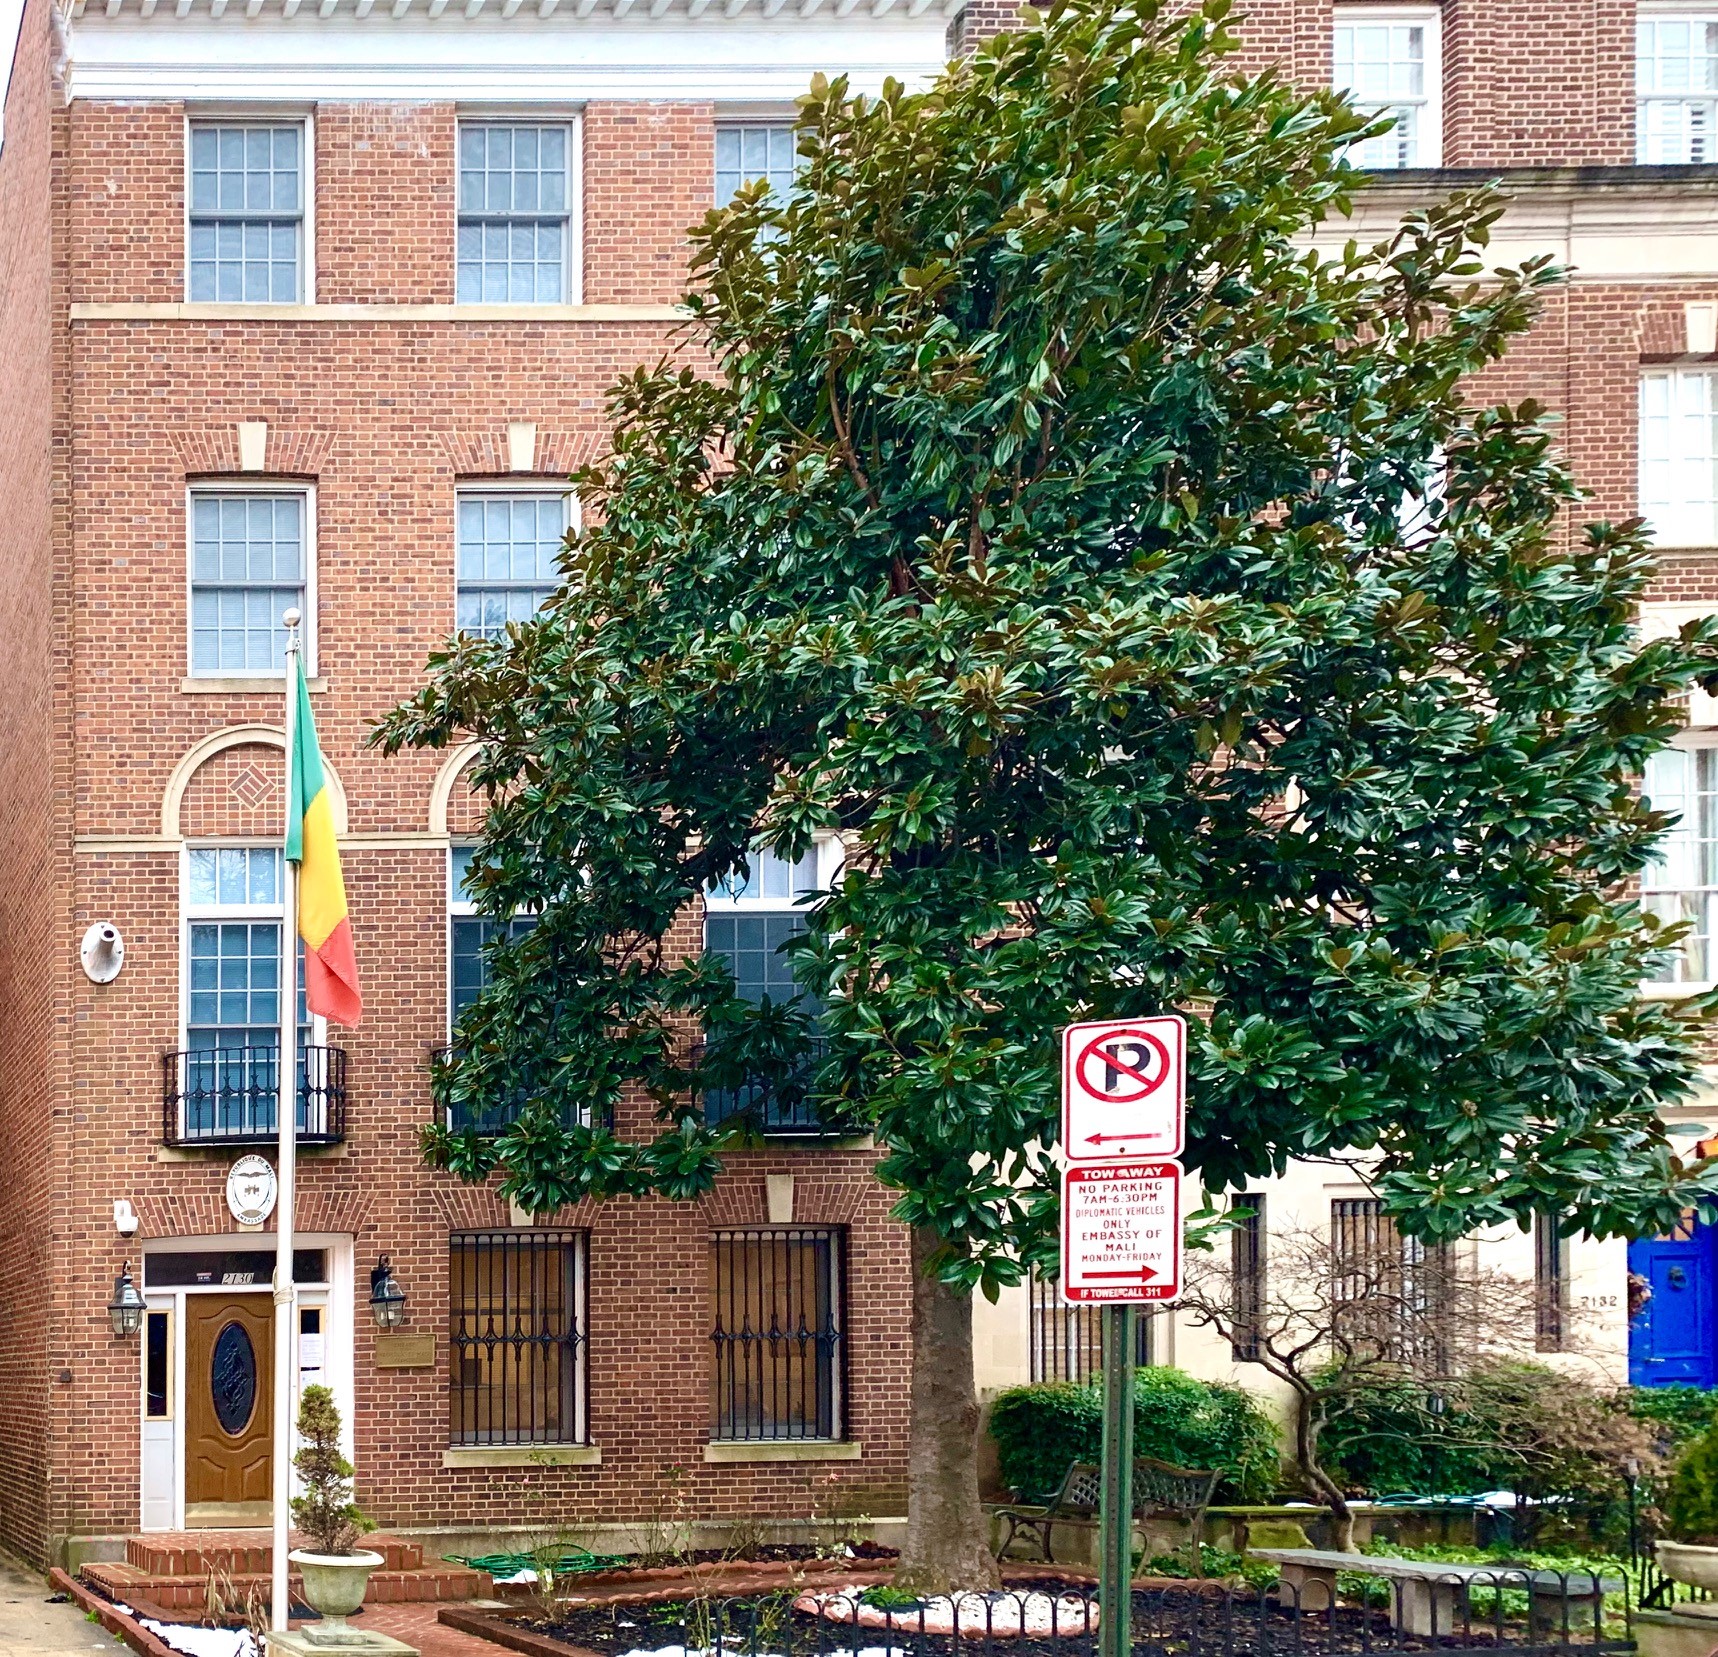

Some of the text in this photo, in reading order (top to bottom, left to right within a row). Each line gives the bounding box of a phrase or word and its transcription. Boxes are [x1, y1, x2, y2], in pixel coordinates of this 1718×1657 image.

[1081, 1166, 1164, 1179] TOW AWAY
[1079, 1181, 1162, 1194] NO PARKING
[1076, 1205, 1165, 1218] DIPLOMATIC VEHICLES
[1103, 1219, 1131, 1229] ONLY
[1082, 1229, 1162, 1241] EMBASSY OF
[1105, 1242, 1136, 1252] MALI
[1081, 1252, 1162, 1263] MONDAY-FRIDAY
[222, 1273, 253, 1284] 2130
[1080, 1289, 1089, 1298] IF
[1123, 1287, 1144, 1297] CALL
[1145, 1287, 1161, 1296] 311
